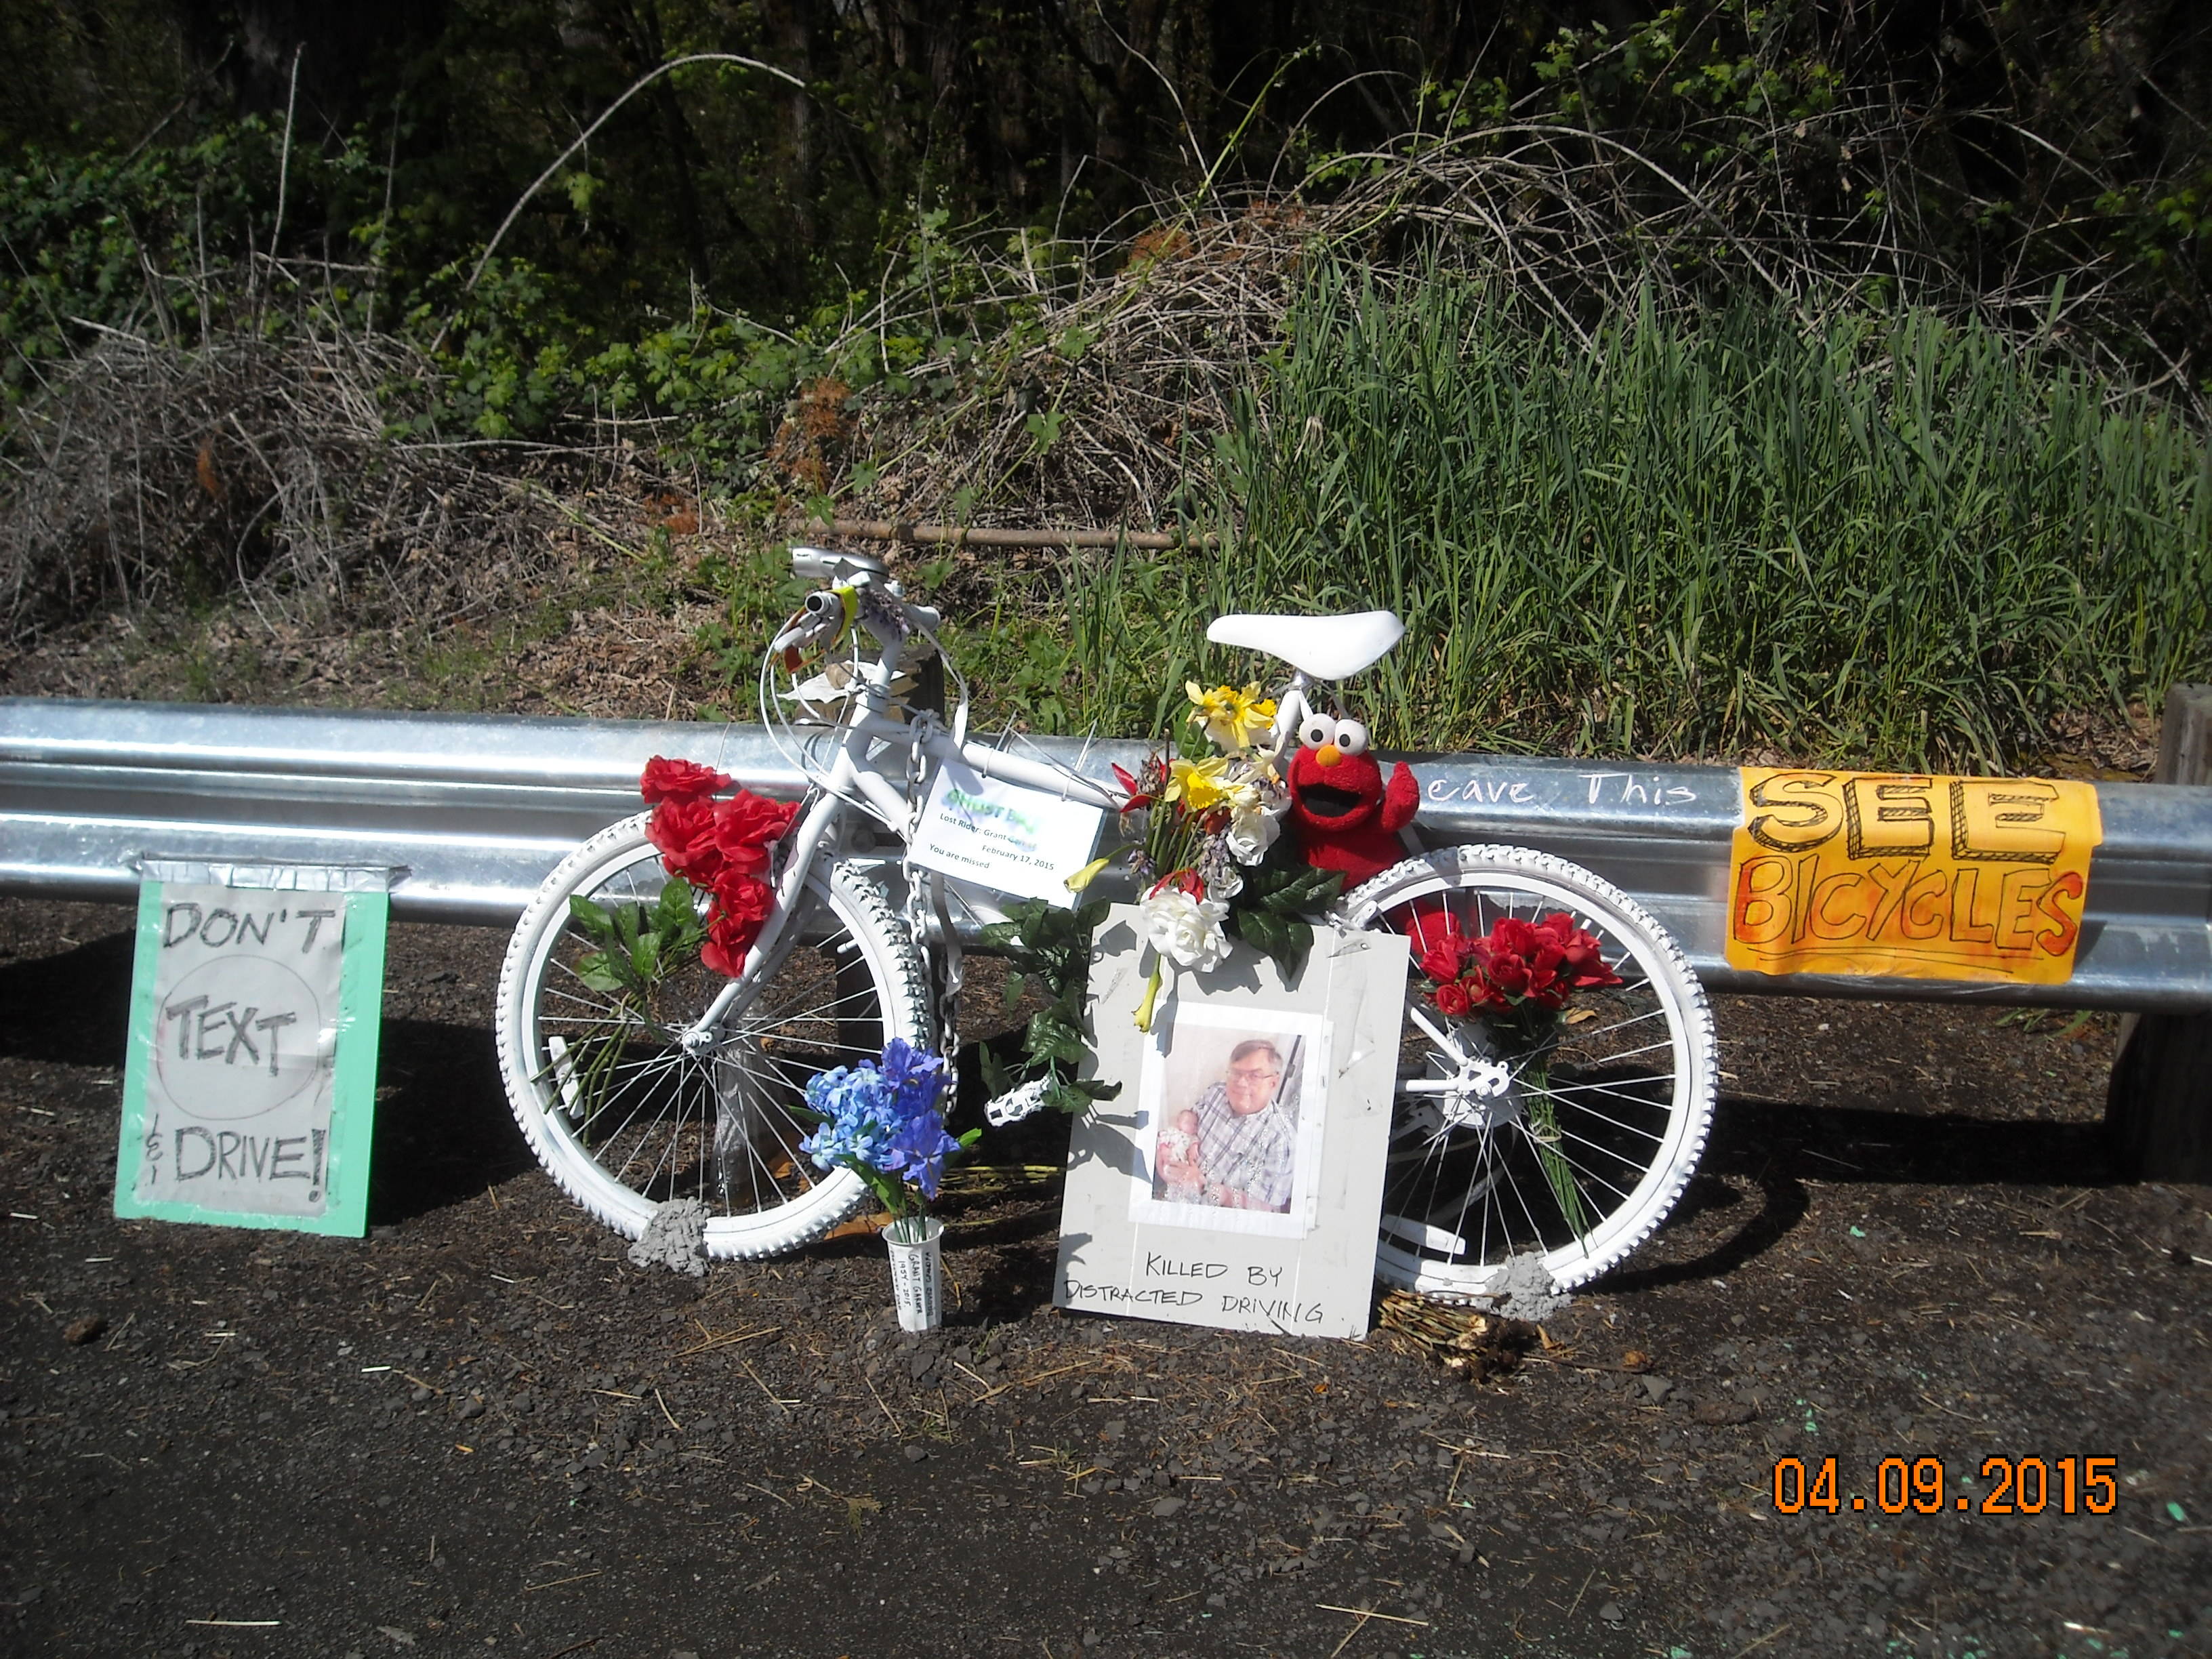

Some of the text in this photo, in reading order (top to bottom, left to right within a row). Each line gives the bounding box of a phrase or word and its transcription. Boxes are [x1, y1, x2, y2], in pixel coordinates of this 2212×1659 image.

[1428, 773, 1696, 805] eave This
[939, 813, 1007, 841] Lost Rider: Grant
[1747, 772, 2066, 865] SEE
[929, 844, 990, 869] You are missed
[982, 844, 1054, 871] February 17, 2015
[1733, 853, 2083, 956] BICYCLES
[163, 903, 335, 953] DON'T
[165, 994, 297, 1077] TEXT
[175, 1126, 326, 1202] DRIVE!
[908, 1254, 921, 1282] GRANT
[1146, 1252, 1282, 1288] KILLED BY
[1064, 1279, 1323, 1324] DISTRACTED DRIVING
